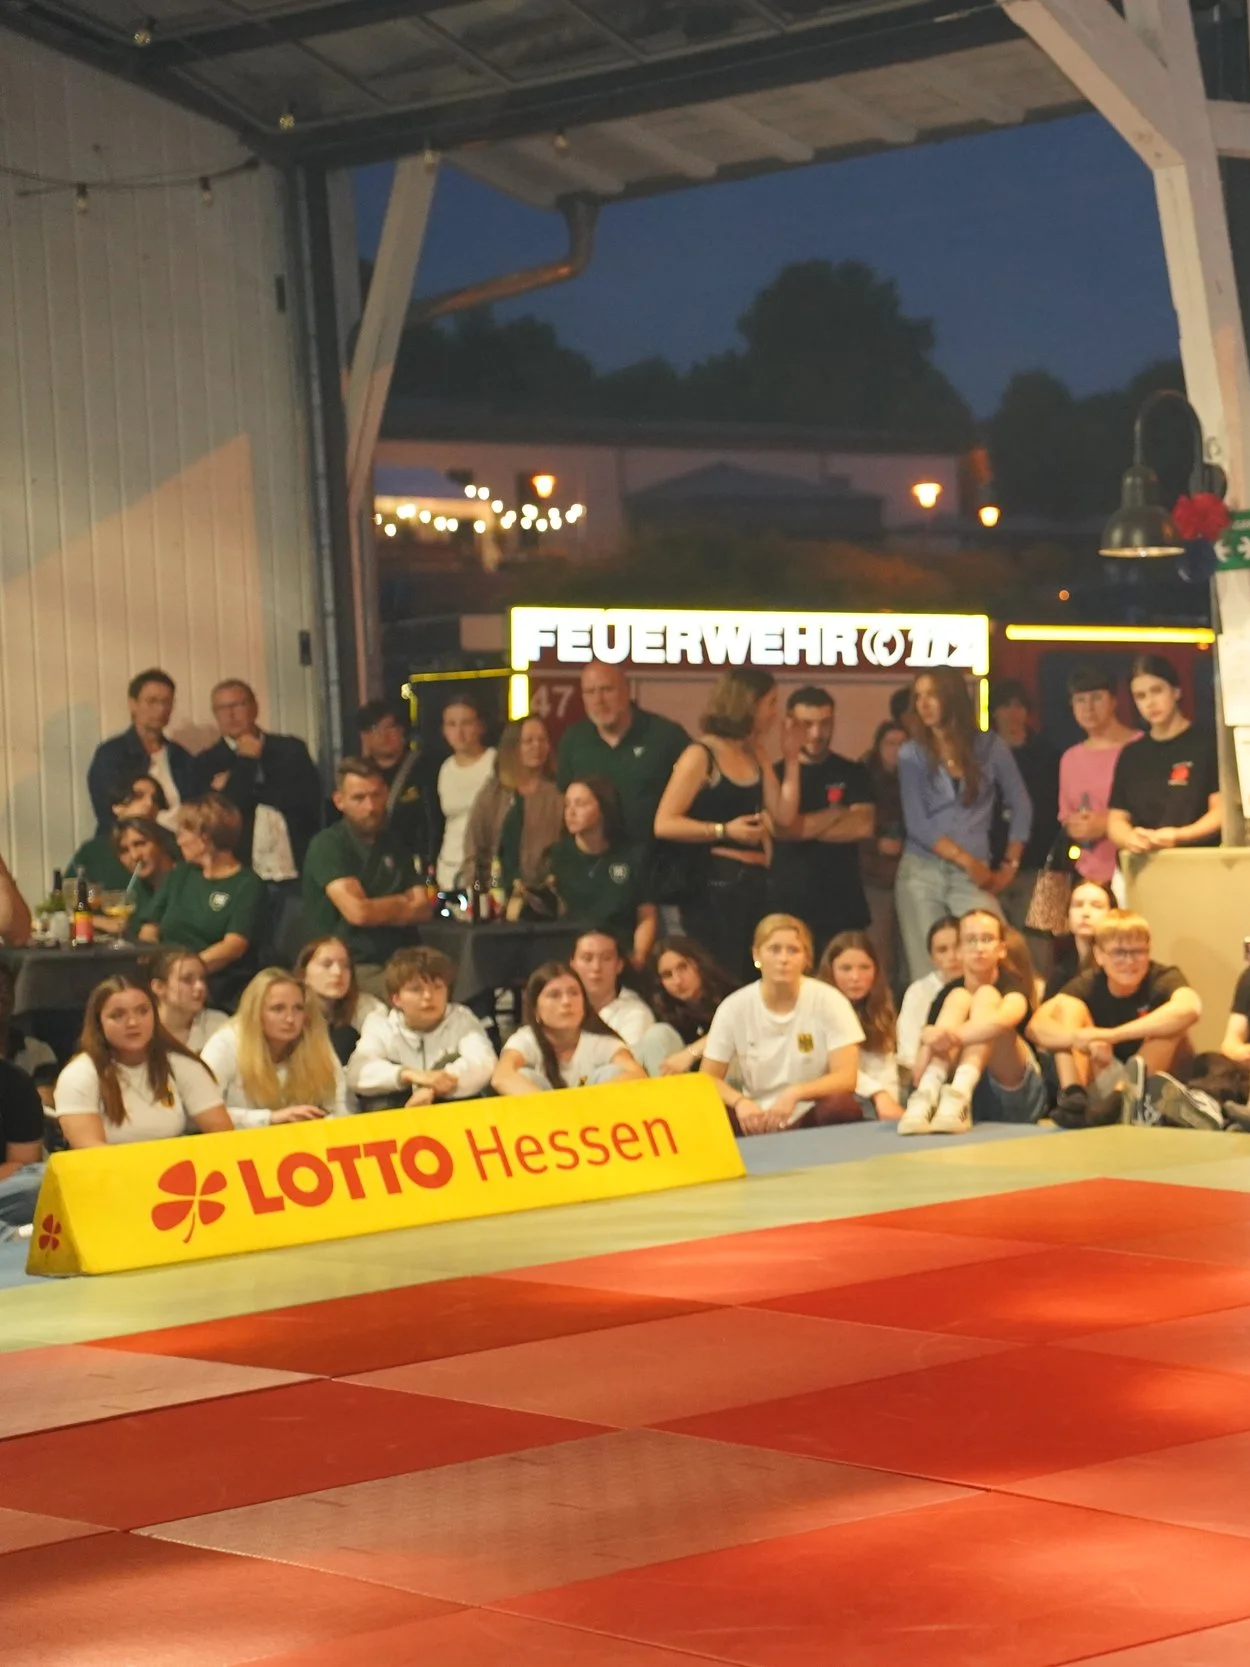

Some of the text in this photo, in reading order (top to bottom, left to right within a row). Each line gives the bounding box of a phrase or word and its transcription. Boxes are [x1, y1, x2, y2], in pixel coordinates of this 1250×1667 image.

[526, 622, 859, 667] FEUERWEHR
[531, 684, 574, 719] 47
[237, 1116, 679, 1215] LOTTO Hessen
